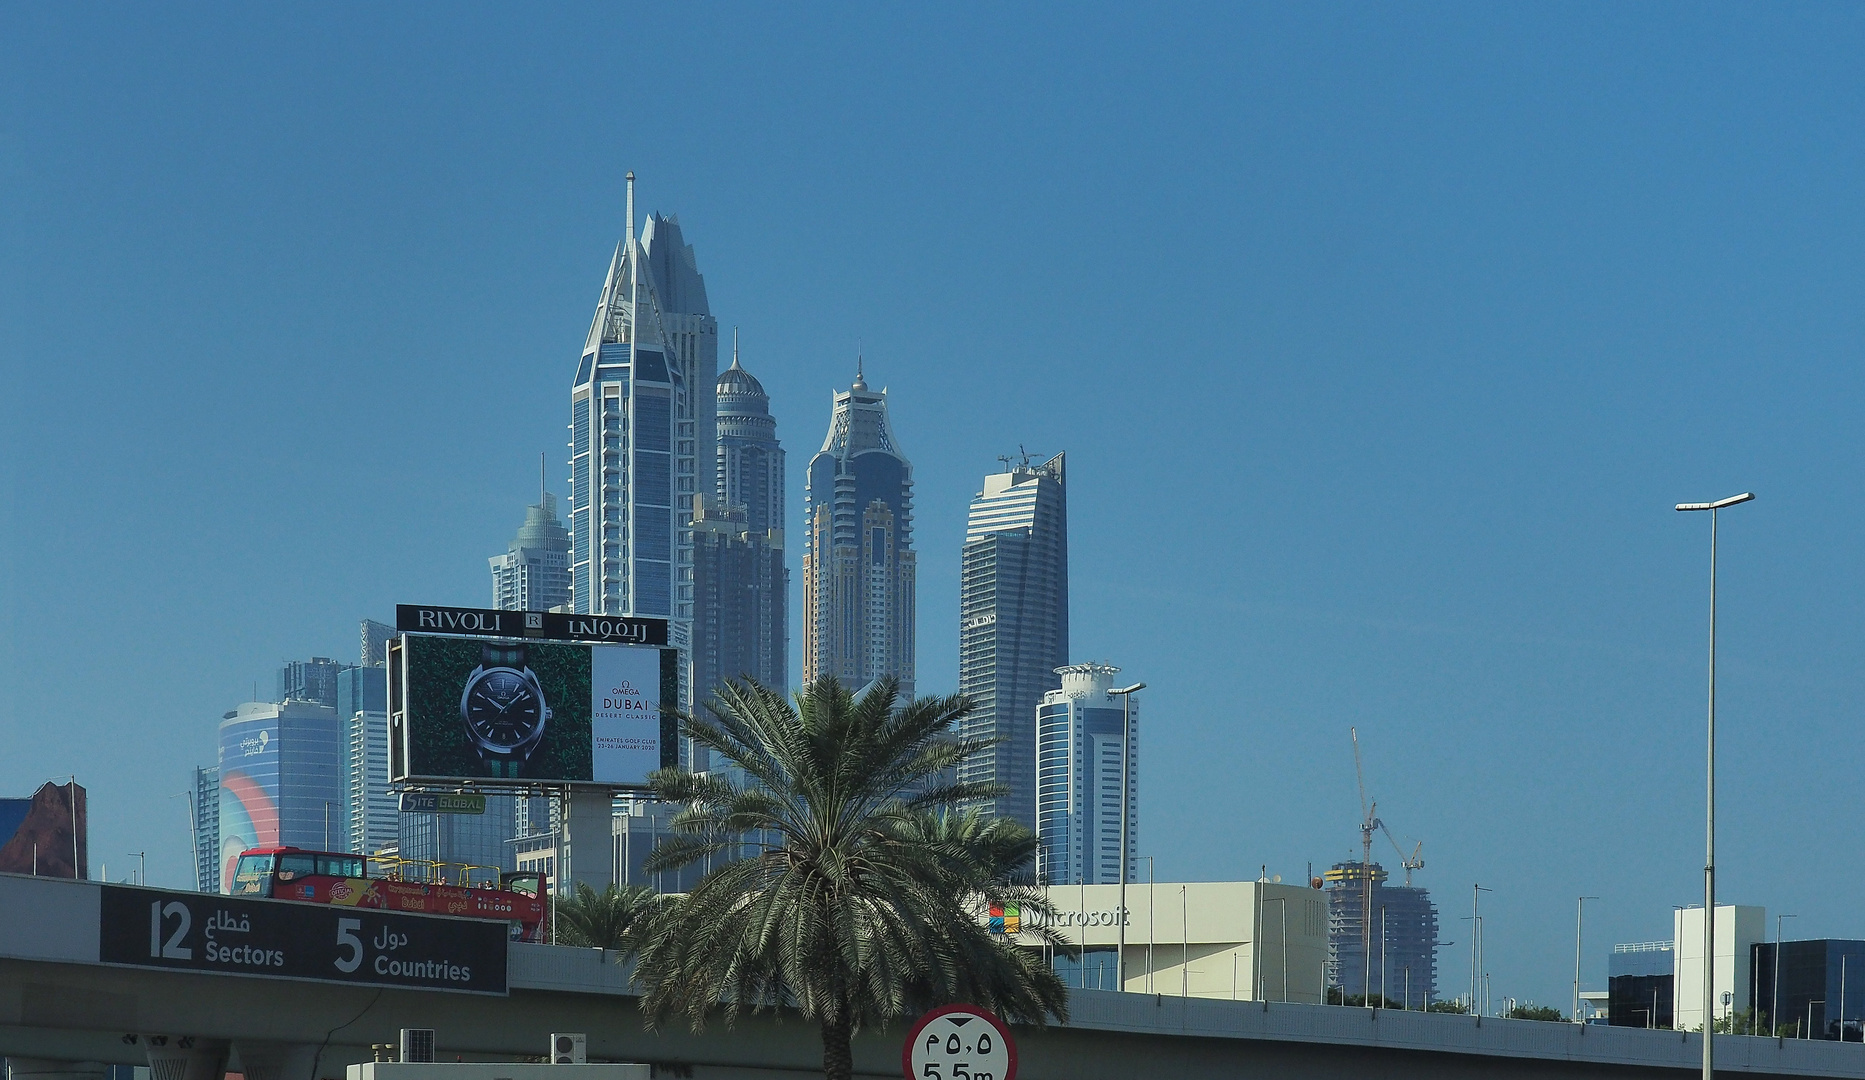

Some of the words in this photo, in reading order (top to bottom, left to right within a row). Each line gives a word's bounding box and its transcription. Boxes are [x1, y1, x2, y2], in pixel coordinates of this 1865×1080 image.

[418, 610, 501, 631] RIVOLI
[529, 616, 539, 625] R
[603, 698, 648, 711] DUBAI
[439, 797, 481, 809] GLOBAL
[150, 900, 192, 960] 12
[205, 910, 250, 939] قطاع
[334, 917, 363, 973] 5
[373, 925, 408, 950] دول
[205, 940, 284, 967] Sectors
[374, 955, 471, 981] Countries
